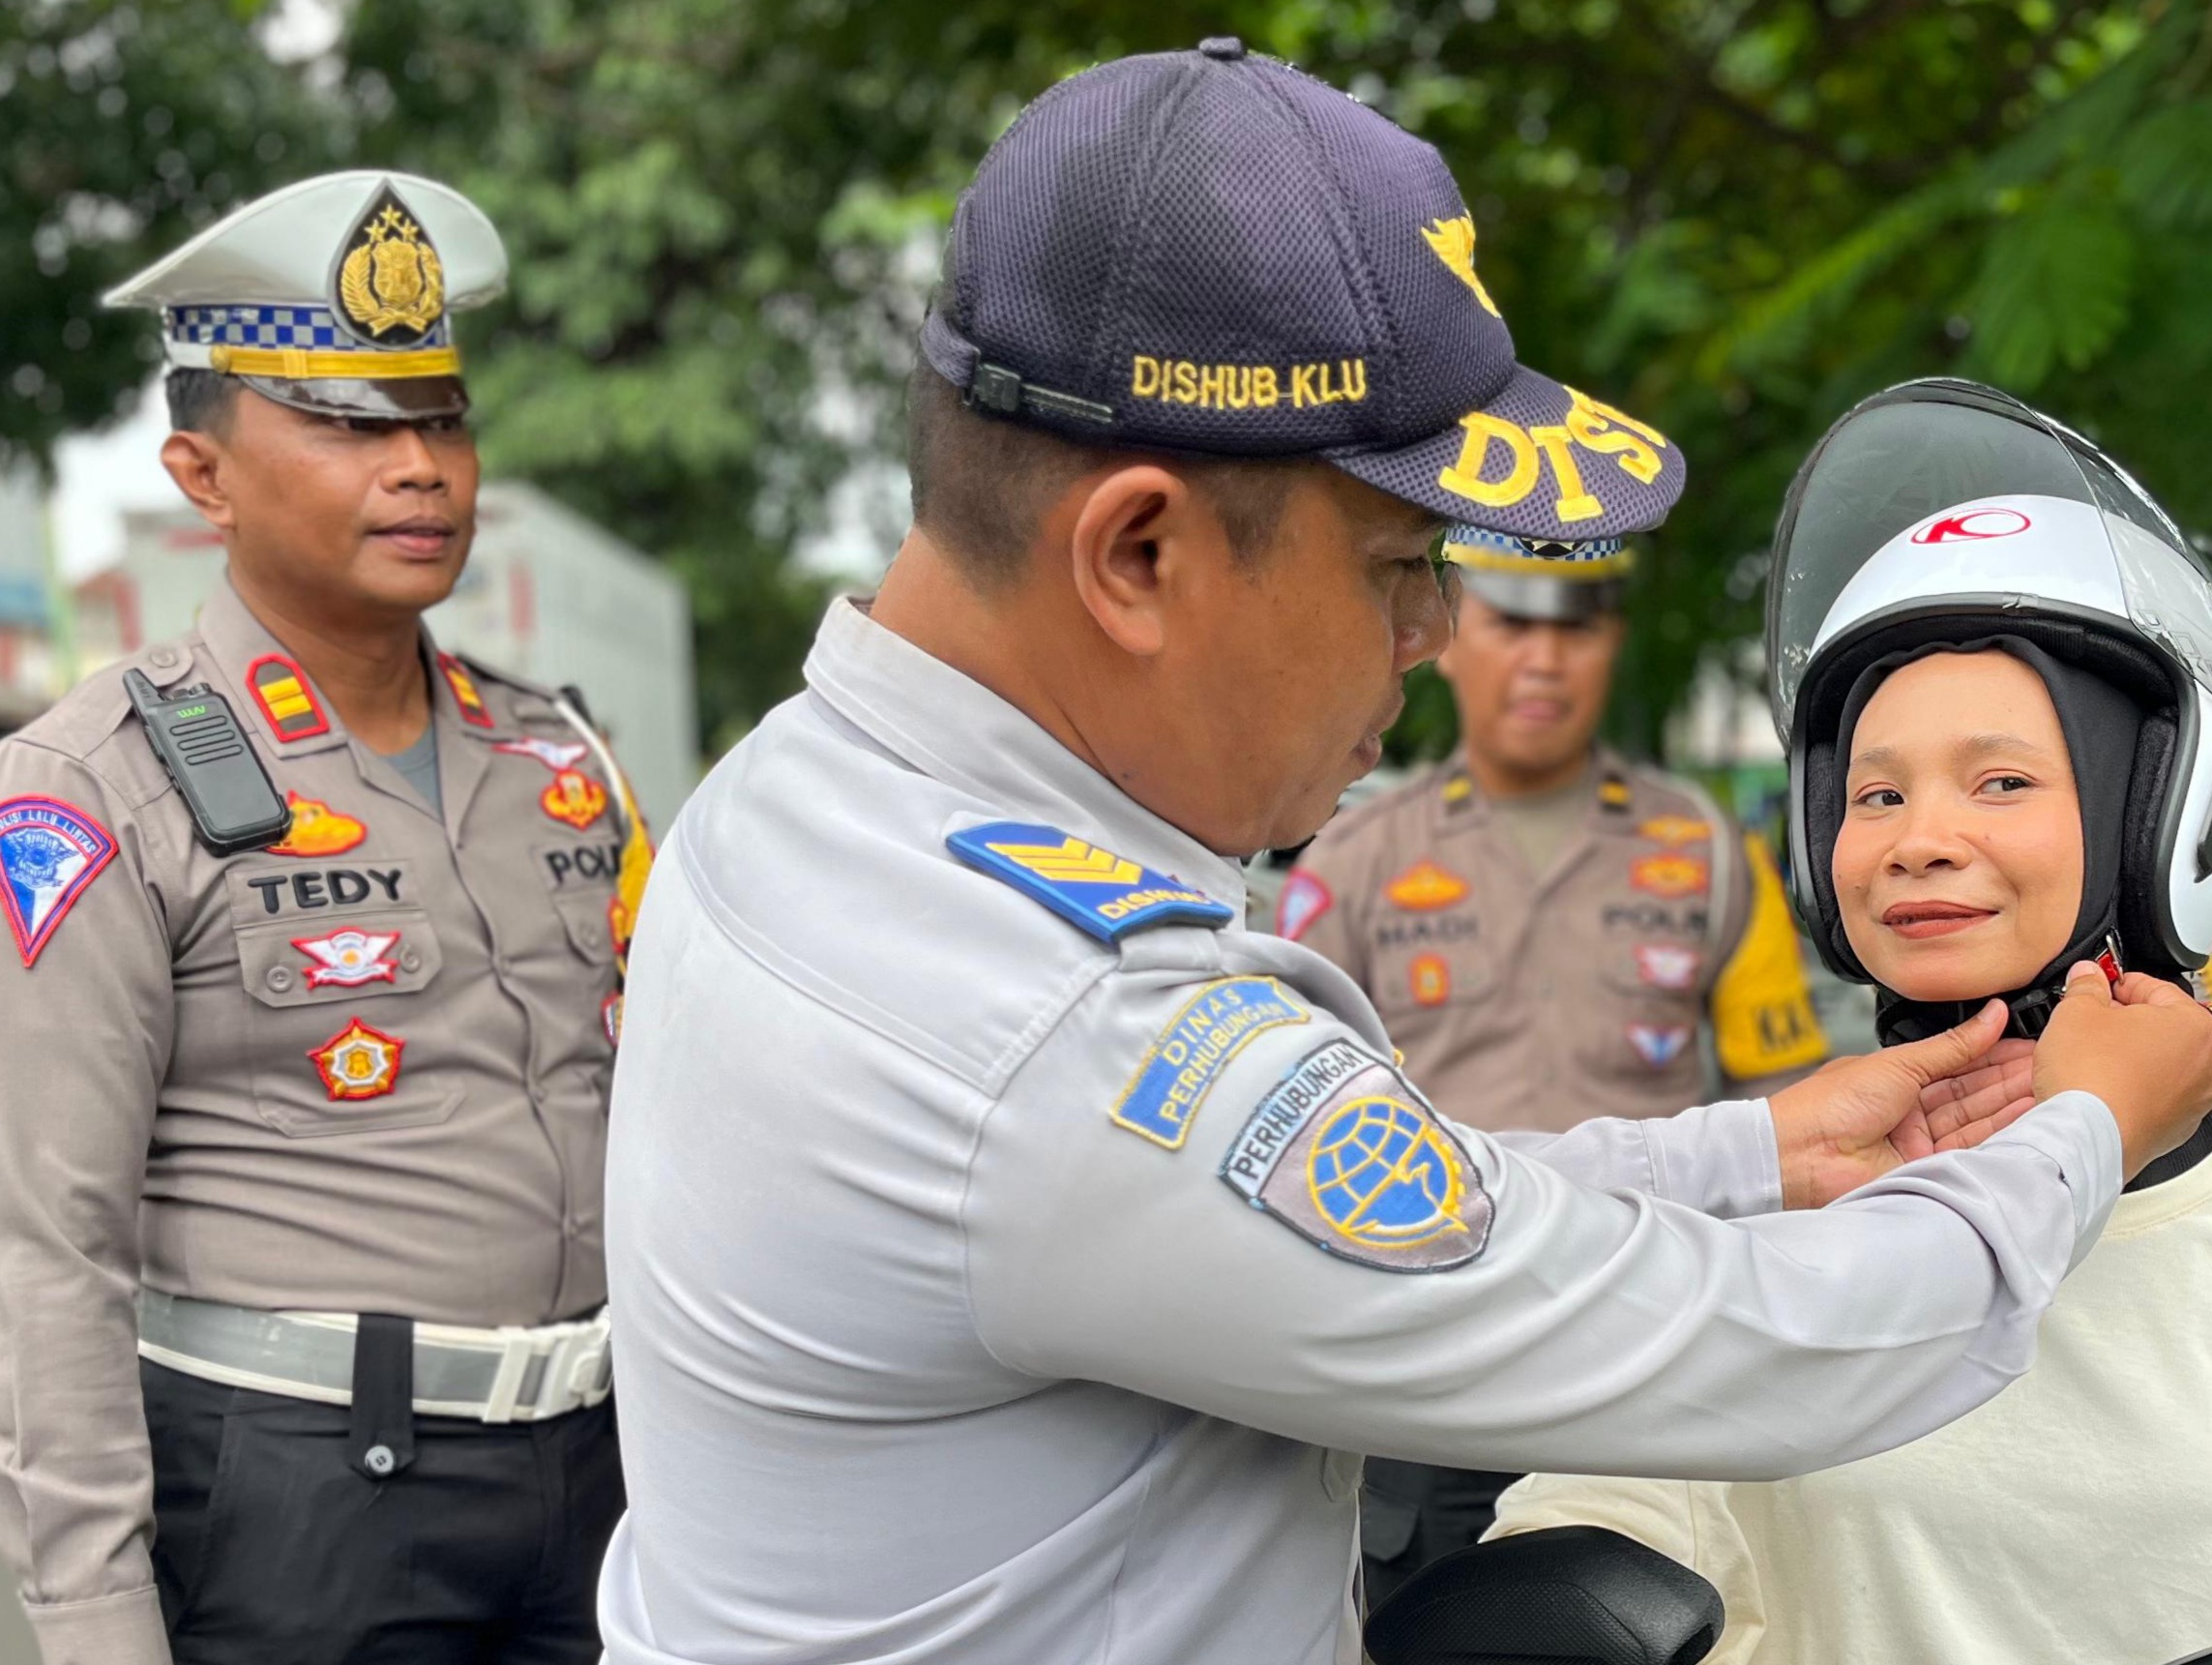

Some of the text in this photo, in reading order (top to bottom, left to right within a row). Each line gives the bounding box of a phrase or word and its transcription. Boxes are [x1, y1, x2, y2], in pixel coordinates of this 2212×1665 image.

[1132, 355, 1367, 410] DISHUB KLU
[247, 868, 401, 914] TEDY
[1160, 1001, 1285, 1123] PERHUBUNGAN
[1162, 988, 1242, 1067] DINAS
[1233, 1046, 1364, 1181] PERHUBUNGAN
